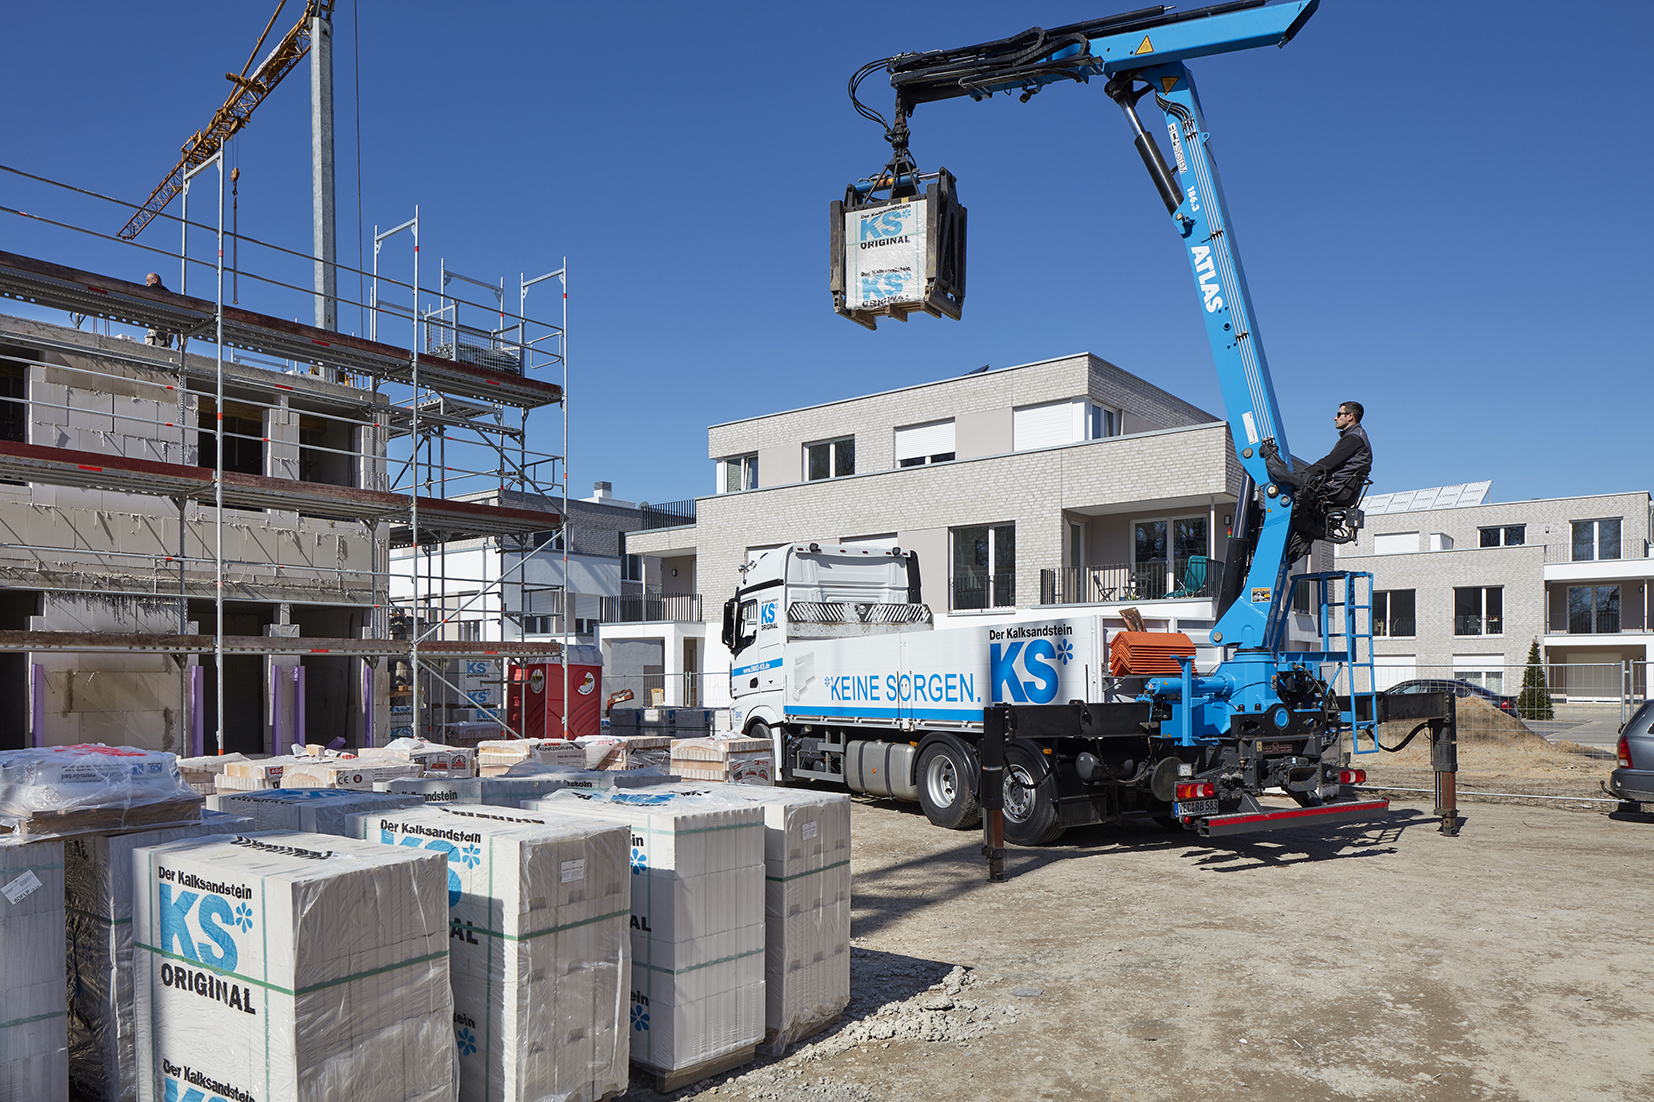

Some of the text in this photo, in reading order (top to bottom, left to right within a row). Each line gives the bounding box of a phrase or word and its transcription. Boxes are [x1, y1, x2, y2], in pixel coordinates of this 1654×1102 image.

[1186, 185, 1200, 213] 186.3
[860, 211, 903, 241] KS
[860, 235, 911, 250] ORIGINAL
[861, 272, 903, 300] KS
[1191, 245, 1223, 314] ATLAS
[761, 603, 775, 624] KS
[761, 623, 778, 631] ORIGINAL
[989, 624, 1073, 641] Der Kalksandstein
[466, 662, 487, 674] KS
[990, 638, 1059, 704] KS
[467, 691, 487, 704] KS
[830, 672, 982, 703] KEINE SORGEN.
[1195, 801, 1205, 812] BB
[1205, 800, 1218, 811] 583
[380, 819, 482, 844] Der Kalksandstein
[158, 866, 252, 900] Der Kalksandstein
[160, 883, 239, 976] KS
[160, 962, 256, 1016] ORIGINAL
[163, 1058, 181, 1078] Der
